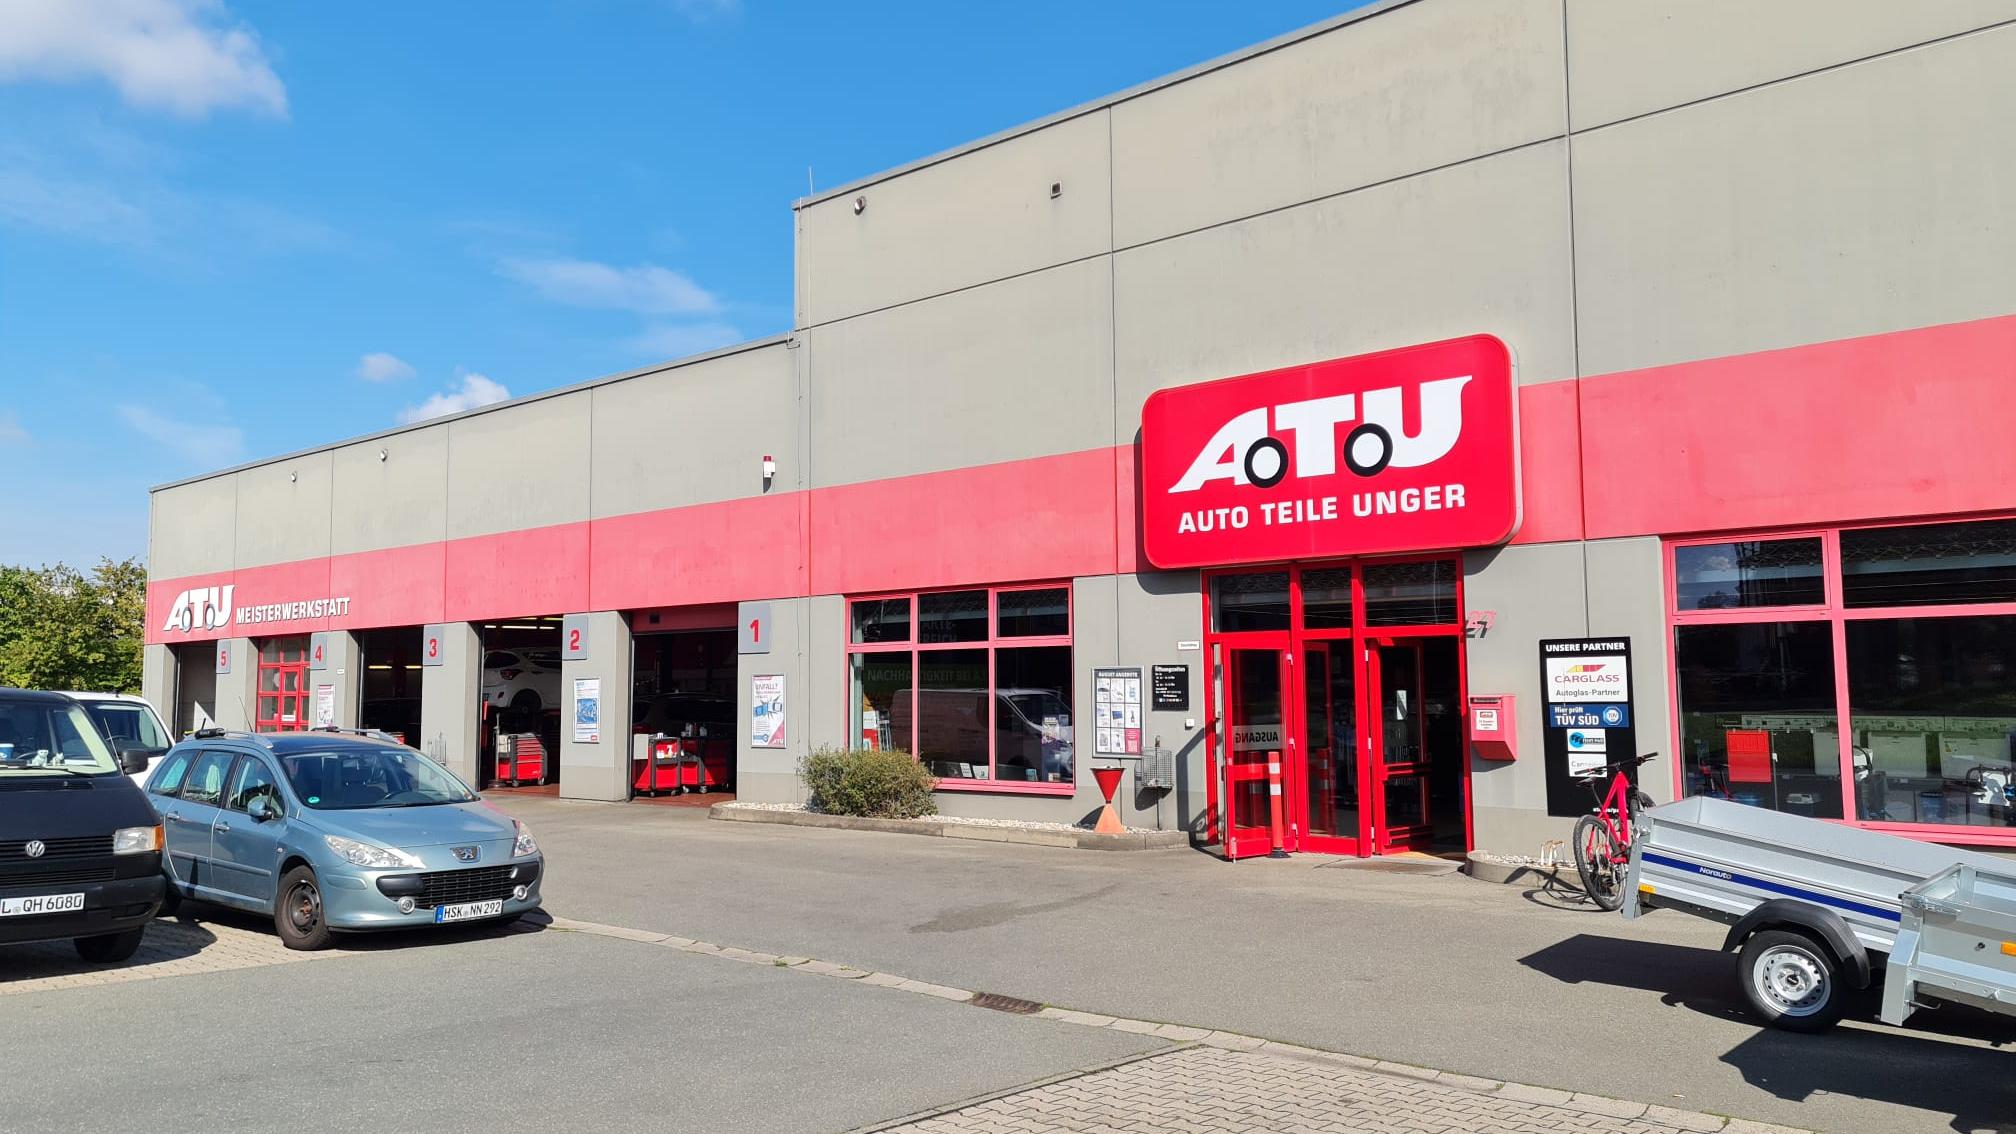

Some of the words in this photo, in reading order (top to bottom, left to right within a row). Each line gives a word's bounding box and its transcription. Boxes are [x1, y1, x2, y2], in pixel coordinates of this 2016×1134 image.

[1177, 505, 1249, 534] AUTO
[1260, 496, 1338, 526] TEILE
[1353, 483, 1466, 518] UNGER
[235, 597, 351, 625] MEISTERWERKSTATT
[750, 619, 759, 642] 1
[428, 638, 437, 657] 3
[569, 629, 580, 650] 2
[1545, 644, 1581, 652] UNSERE
[1582, 642, 1626, 651] PARTNER
[220, 650, 227, 667] 5
[314, 645, 322, 662] 4
[1554, 674, 1620, 683] CARGLASS
[1555, 688, 1620, 697] Autoglas-Partner
[1568, 706, 1584, 714] prüft
[1555, 713, 1576, 725] TÜV
[1578, 713, 1600, 725] SÜD
[1699, 866, 1732, 880] Norauto
[23, 898, 43, 913] QH
[46, 894, 83, 910] 6080
[444, 906, 464, 919] HSK
[470, 904, 483, 916] NN
[484, 901, 501, 914] 292
